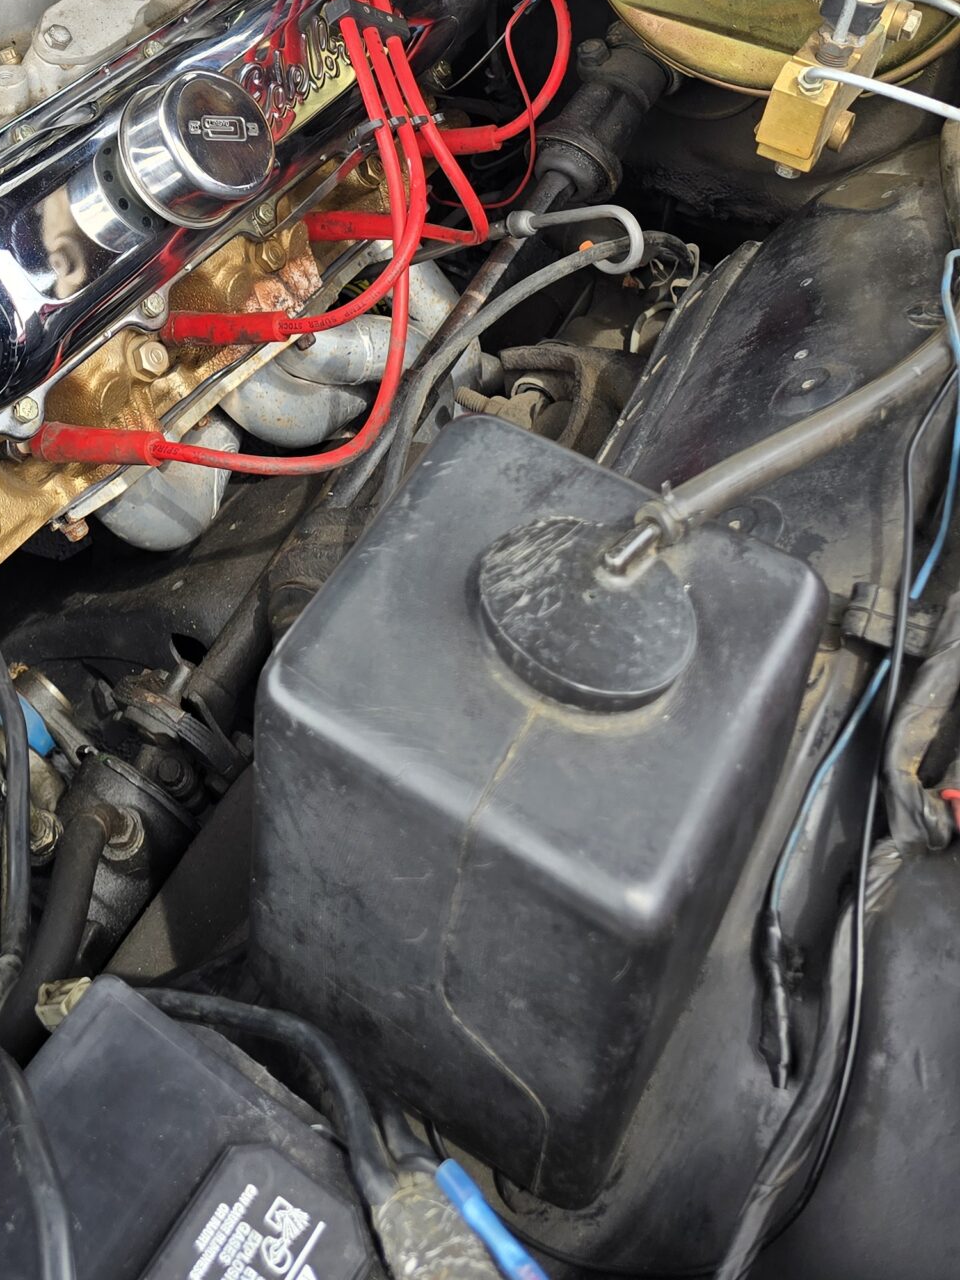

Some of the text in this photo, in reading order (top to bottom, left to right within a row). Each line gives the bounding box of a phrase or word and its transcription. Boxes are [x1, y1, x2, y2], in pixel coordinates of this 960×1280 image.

[278, 322, 303, 330] STOCK
[308, 317, 338, 329] SUPER
[151, 444, 178, 456] SPIRA
[194, 1214, 221, 1254] INJURY
[218, 1221, 251, 1267] GASES
